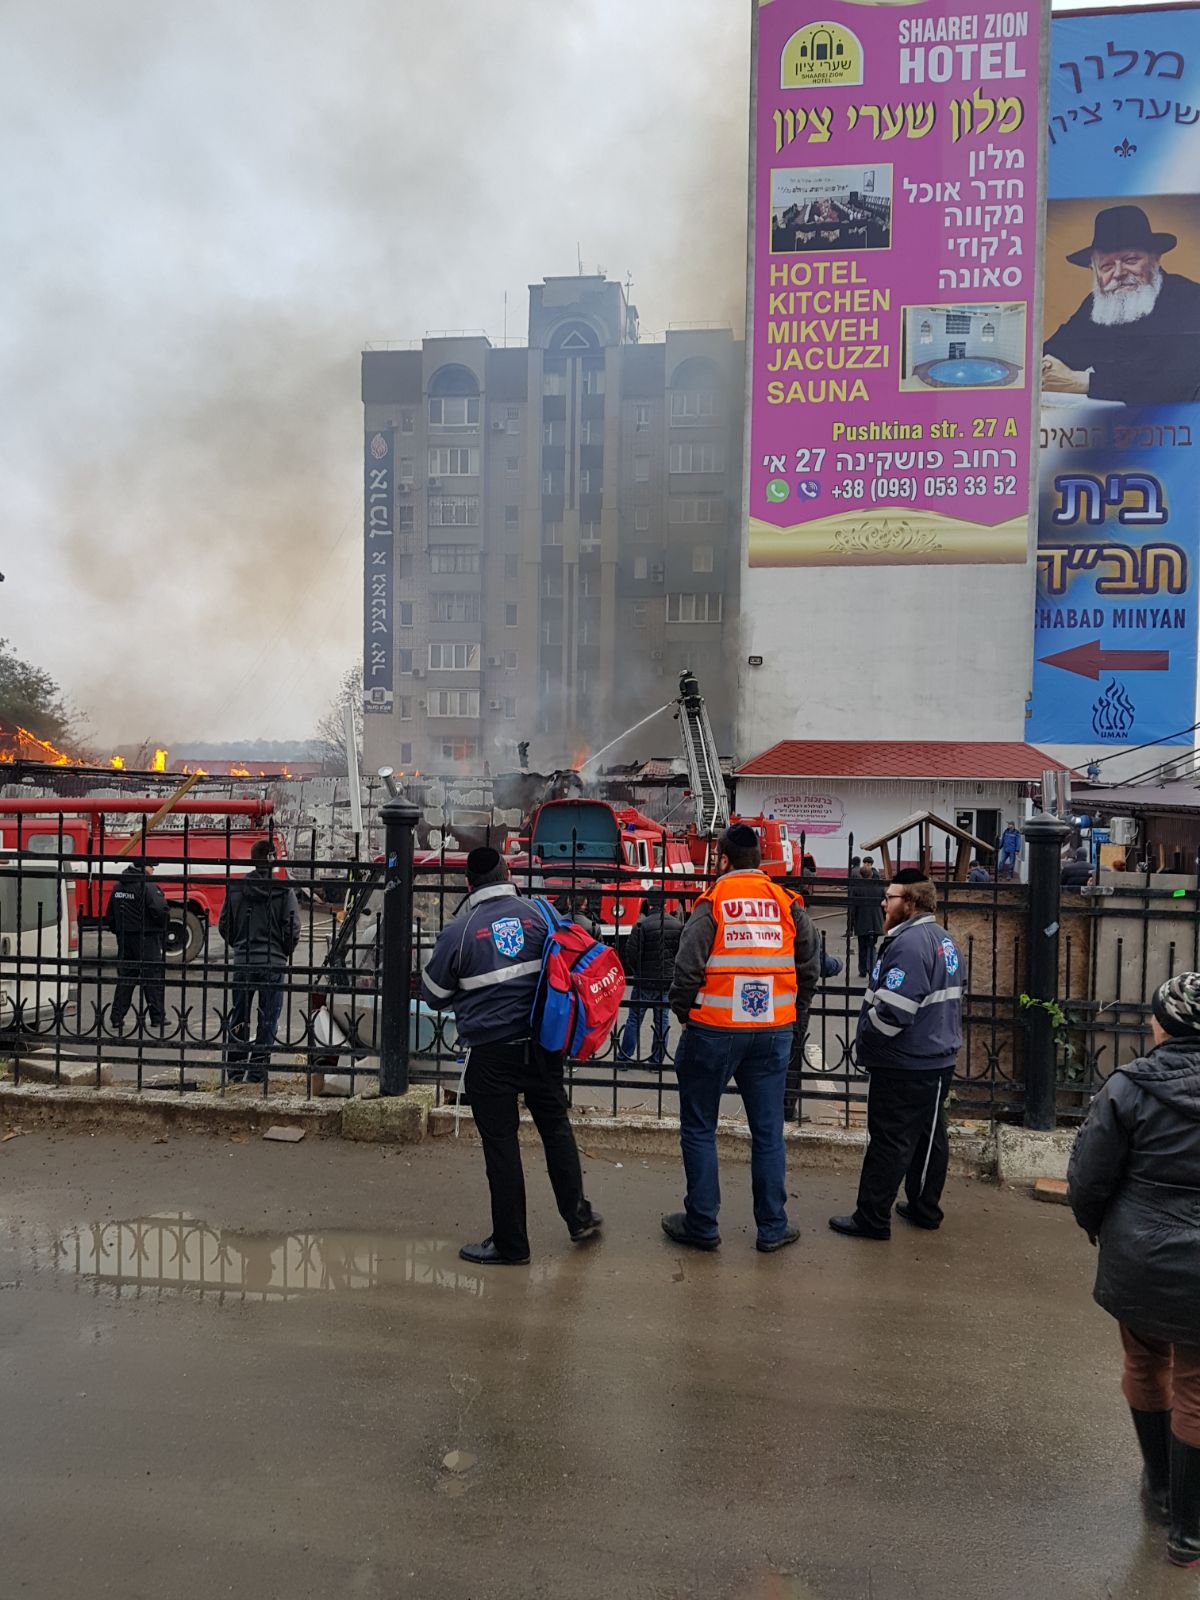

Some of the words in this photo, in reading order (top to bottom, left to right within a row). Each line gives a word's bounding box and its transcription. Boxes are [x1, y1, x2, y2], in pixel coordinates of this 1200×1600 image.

[899, 15, 978, 44] SHAAREI
[983, 11, 1028, 40] ZION
[795, 62, 814, 76] ציון
[820, 60, 852, 72] שערי
[900, 41, 1026, 84] HOTEL
[801, 72, 828, 80] SHAAREI
[847, 100, 936, 141] שערי
[949, 86, 1025, 144] מלון
[1113, 98, 1200, 125] שערי
[772, 105, 834, 154] ציון
[969, 143, 1025, 177] מלון
[903, 177, 961, 203] אוכל
[970, 179, 1024, 200] חדר
[944, 204, 1024, 232] מקווה
[769, 261, 867, 287] HOTEL
[938, 266, 1023, 289] סאונה
[769, 288, 891, 315] KITCHEN
[767, 318, 879, 344] MIKVEH
[767, 345, 889, 372] JACUZZI
[766, 378, 870, 404] SAUNA
[832, 420, 923, 442] Pushkina
[930, 419, 964, 439] str.
[972, 417, 998, 438] 27
[1003, 417, 1018, 437] A
[795, 448, 826, 473] 27
[836, 450, 944, 477] פושקינה
[953, 448, 1017, 469] רחוב
[831, 478, 864, 499] +38
[870, 477, 917, 502] (093)
[924, 475, 958, 497] 053
[964, 475, 987, 496] 33
[993, 475, 1017, 496] 52
[1054, 475, 1167, 524] בית
[1112, 608, 1186, 629] MINYAN
[1101, 731, 1128, 739] UMAN
[724, 901, 778, 918] חובש
[726, 930, 753, 941] הצלה
